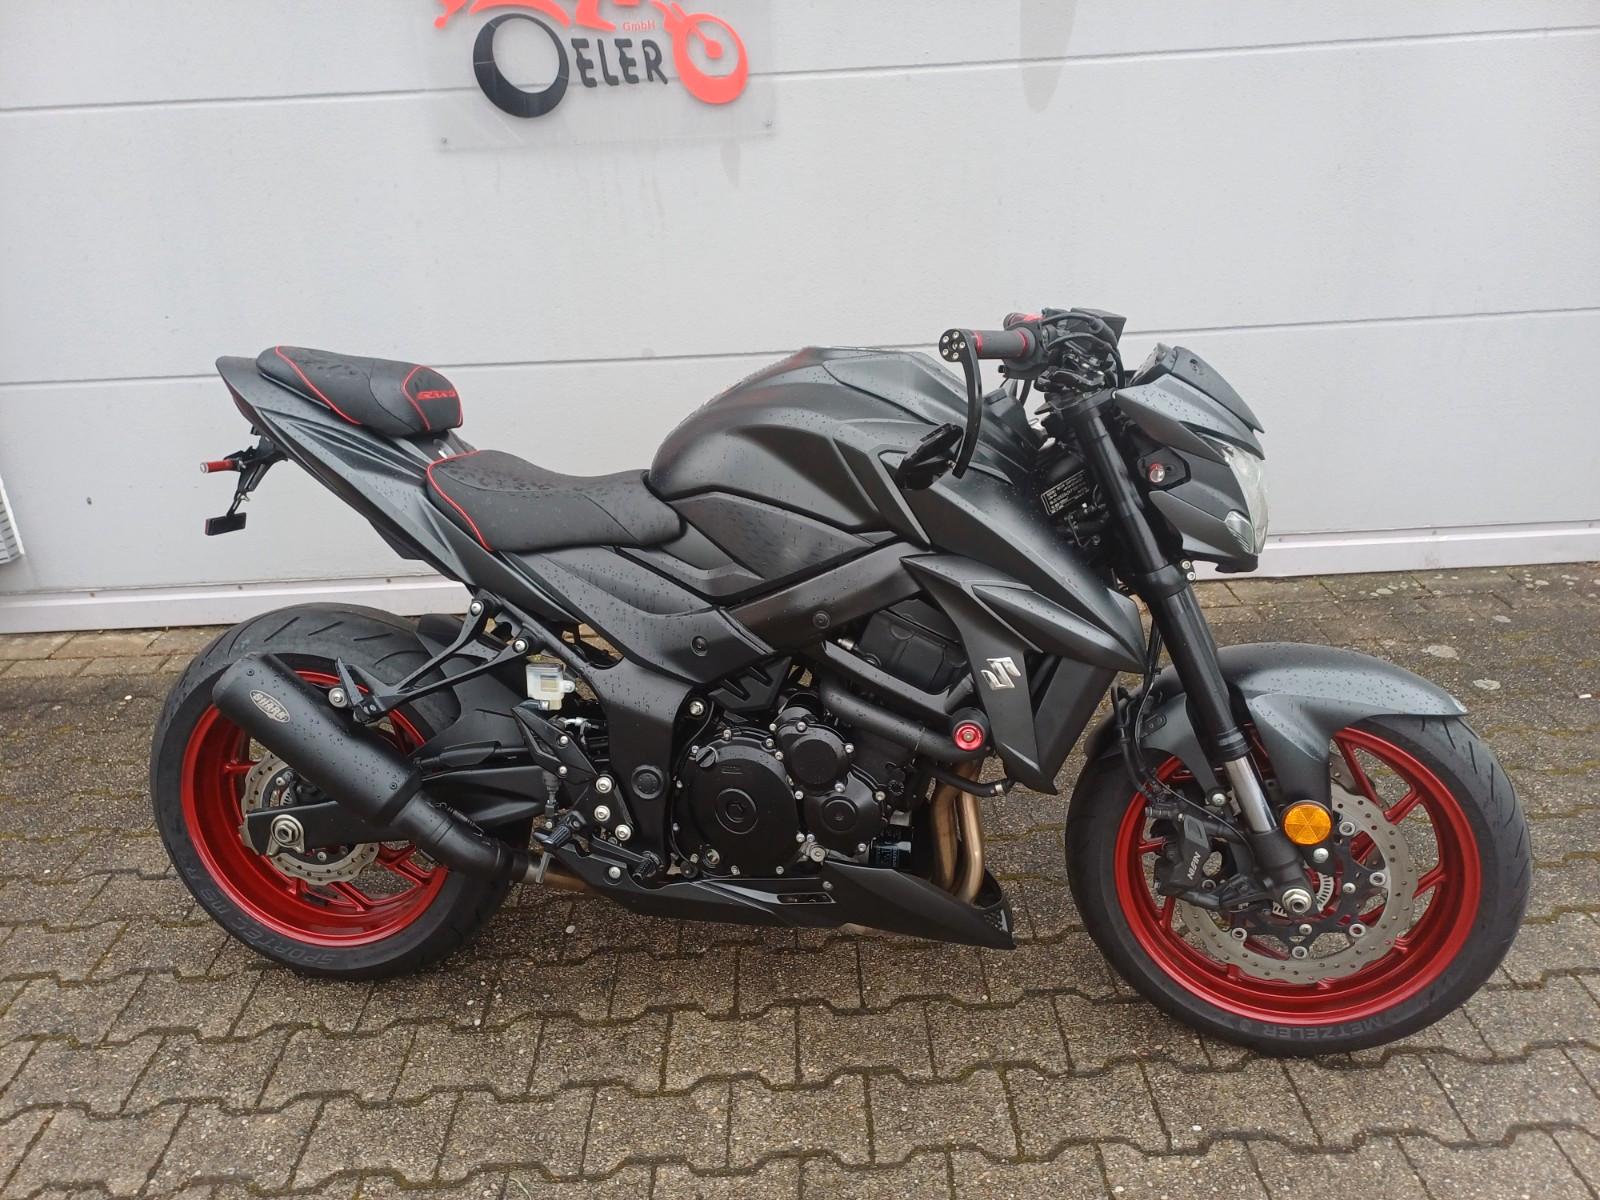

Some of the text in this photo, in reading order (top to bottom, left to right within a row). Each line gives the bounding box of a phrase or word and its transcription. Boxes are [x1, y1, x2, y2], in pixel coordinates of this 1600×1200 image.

[622, 20, 656, 32] GmbH
[252, 692, 288, 720] SHARK
[232, 916, 336, 965] SPORTEC
[1263, 1016, 1383, 1040] METZELER
